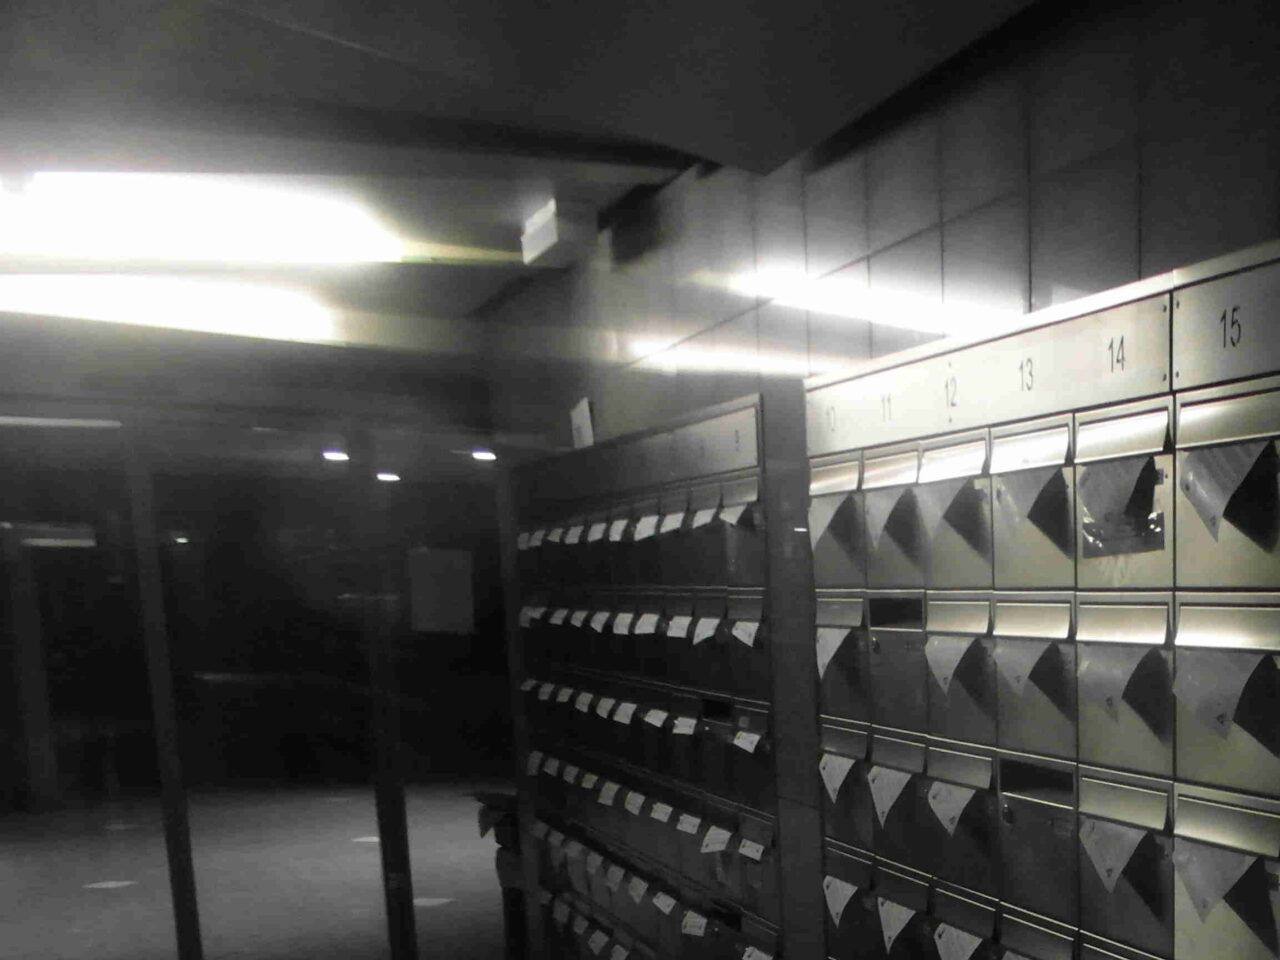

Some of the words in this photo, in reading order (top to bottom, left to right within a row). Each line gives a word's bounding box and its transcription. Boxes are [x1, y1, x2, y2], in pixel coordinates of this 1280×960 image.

[1220, 305, 1241, 348] 15
[1108, 335, 1124, 372] 14
[1019, 357, 1034, 391] 13
[881, 393, 892, 422] 11
[945, 376, 958, 408] 12
